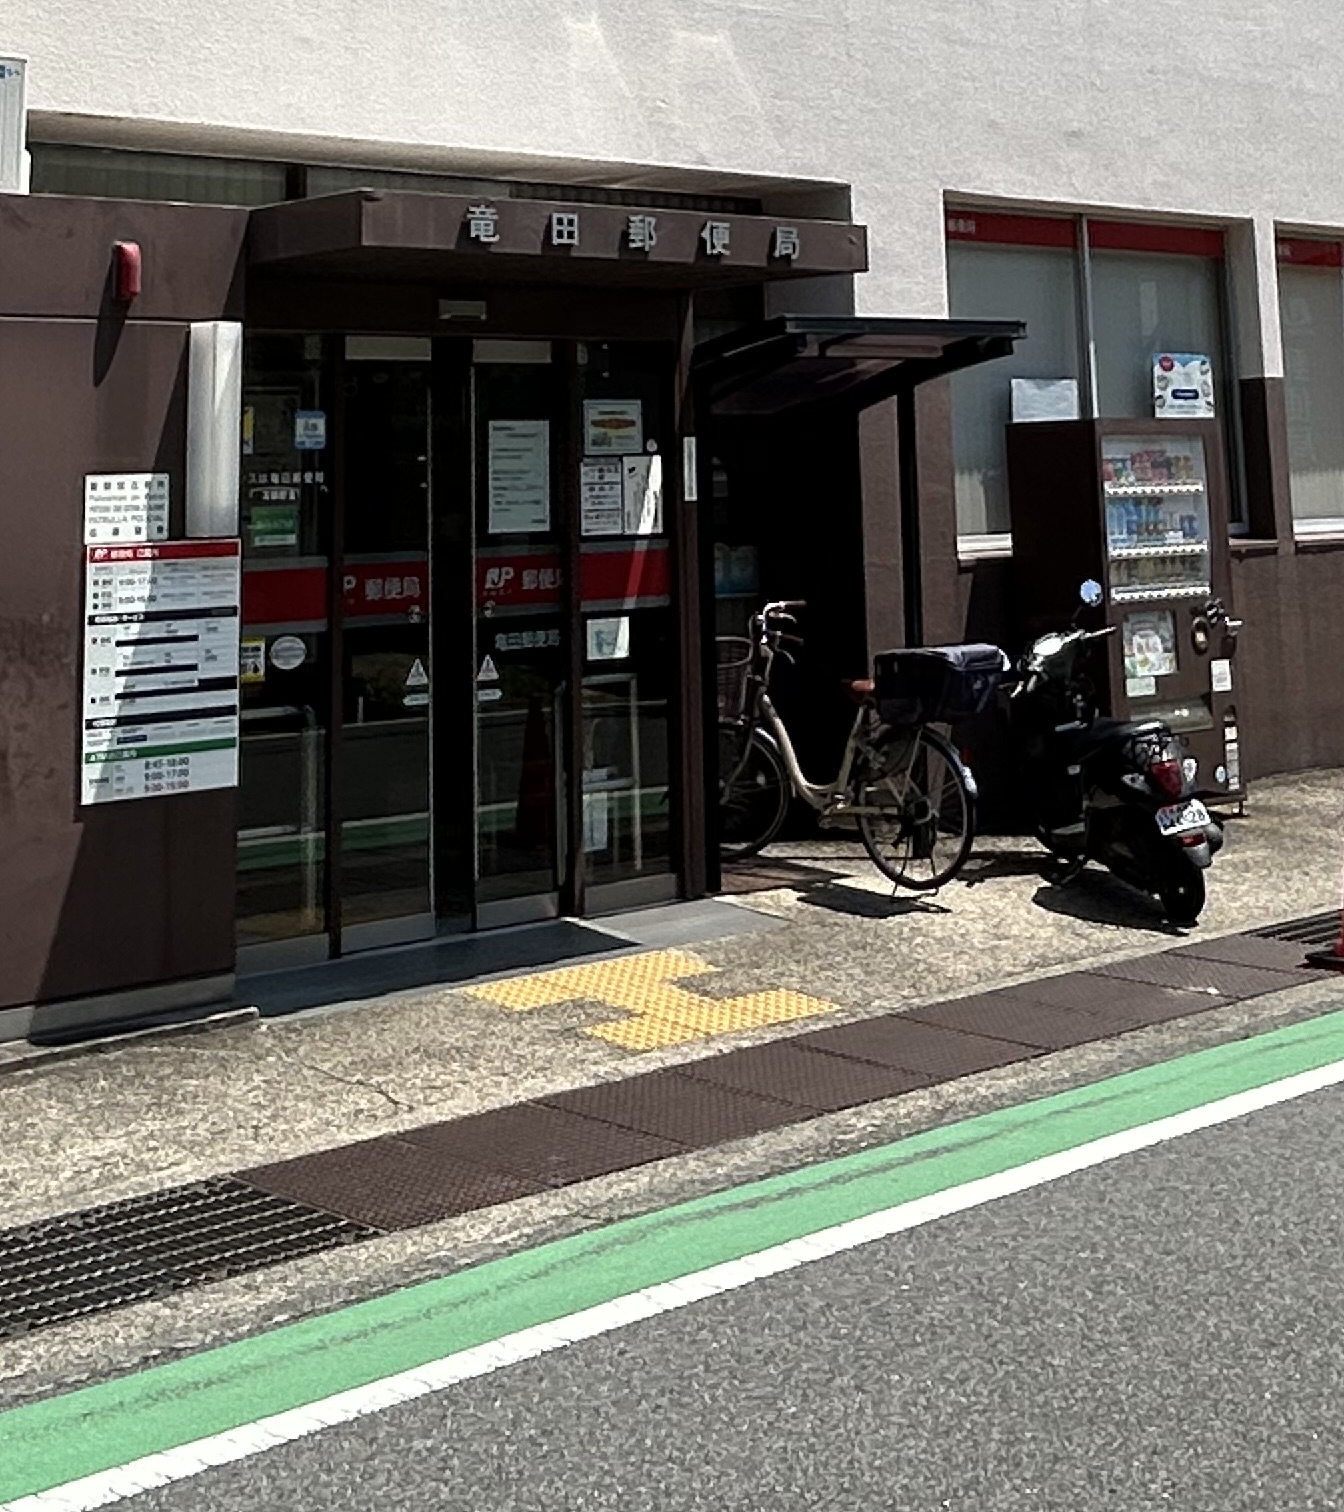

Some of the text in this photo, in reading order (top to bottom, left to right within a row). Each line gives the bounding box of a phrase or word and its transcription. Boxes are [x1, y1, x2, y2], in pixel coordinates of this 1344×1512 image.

[466, 204, 801, 262] 竜田郵便局
